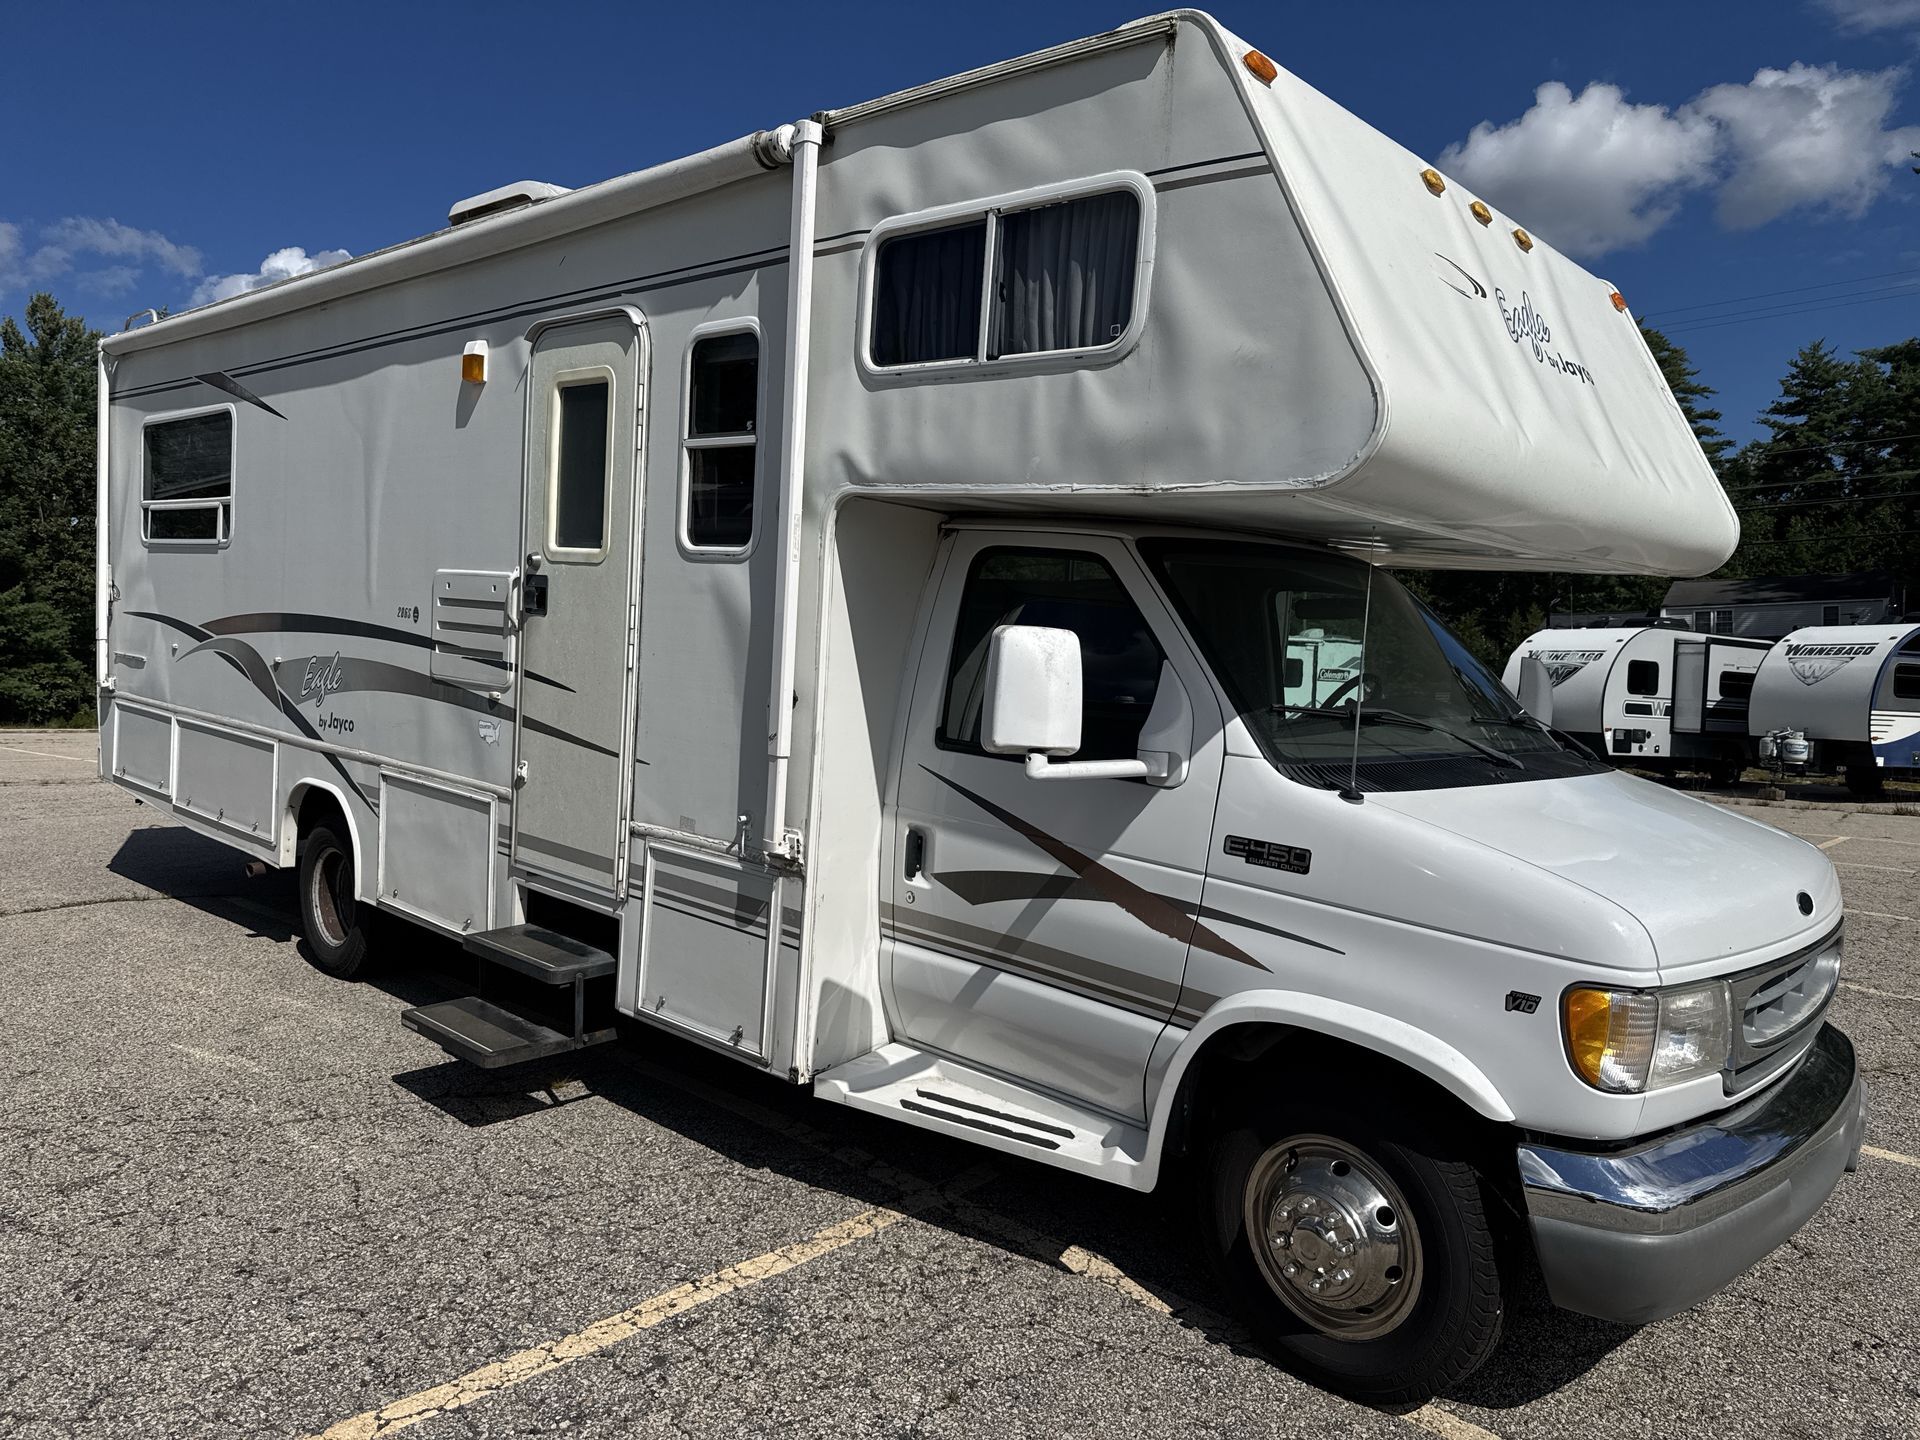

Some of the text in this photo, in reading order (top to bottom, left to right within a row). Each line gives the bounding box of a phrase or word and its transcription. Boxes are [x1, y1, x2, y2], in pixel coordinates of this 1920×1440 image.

[1495, 287, 1550, 363] Eagle
[1544, 350, 1595, 386] by Jayco
[1785, 644, 1877, 656] WINNEBAGO
[301, 650, 343, 708] Eagle
[1319, 669, 1344, 680] Coleman
[318, 712, 355, 734] by Jayco
[1249, 857, 1306, 873] SUPER DUTY
